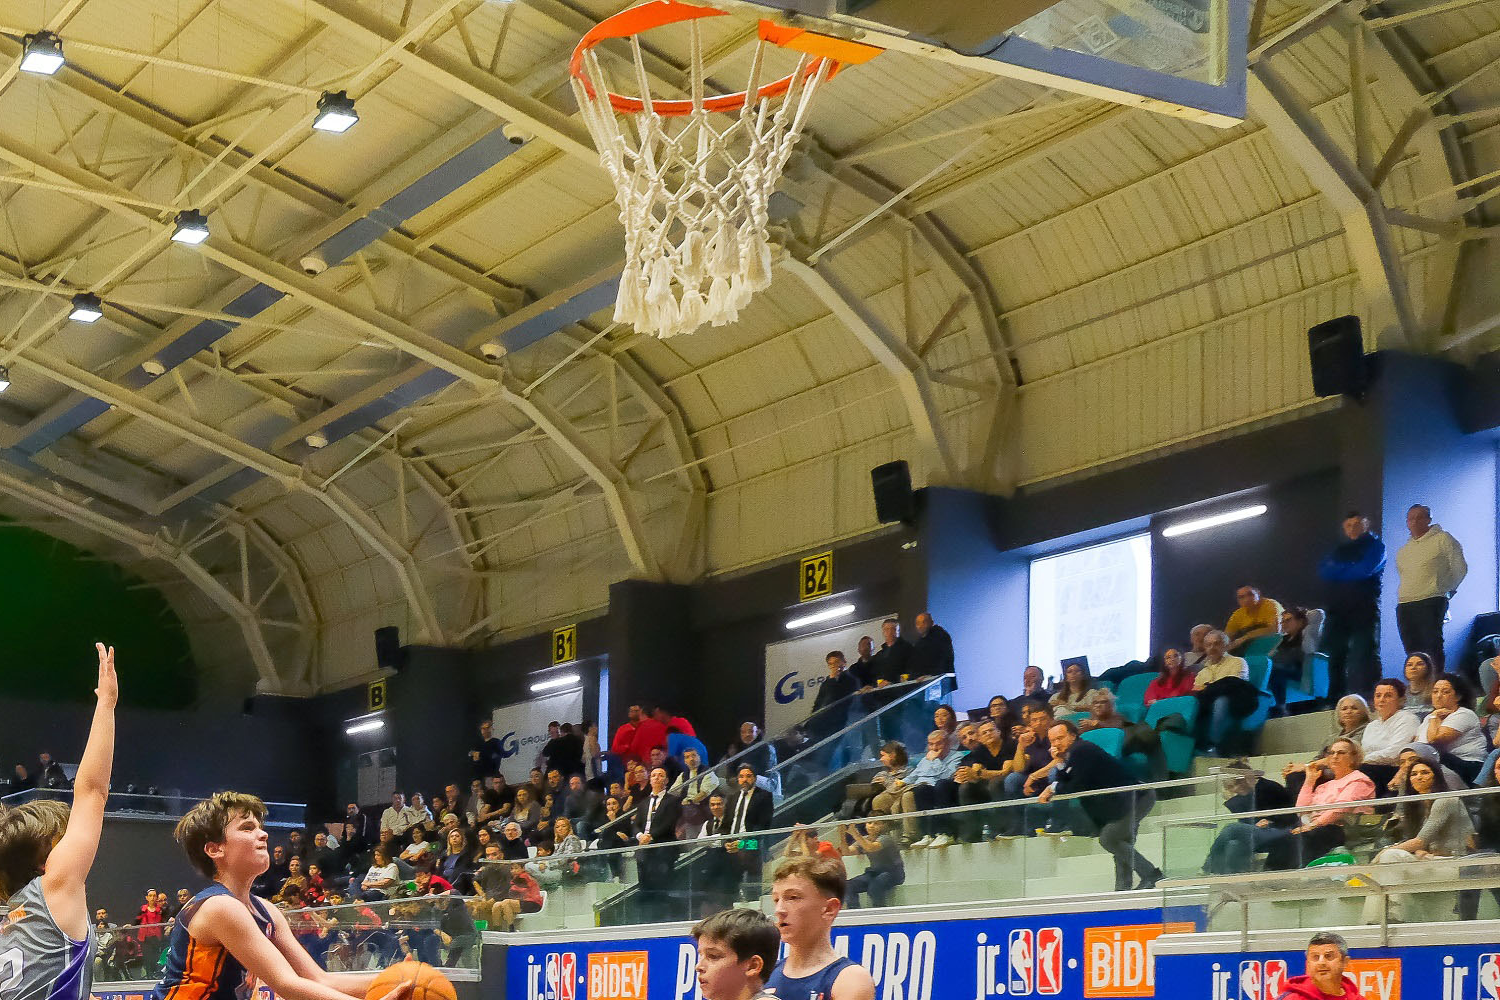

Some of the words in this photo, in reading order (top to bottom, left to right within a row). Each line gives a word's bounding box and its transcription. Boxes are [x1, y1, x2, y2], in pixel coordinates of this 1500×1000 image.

[805, 559, 827, 595] B2
[555, 633, 574, 661] B1
[371, 685, 383, 707] B
